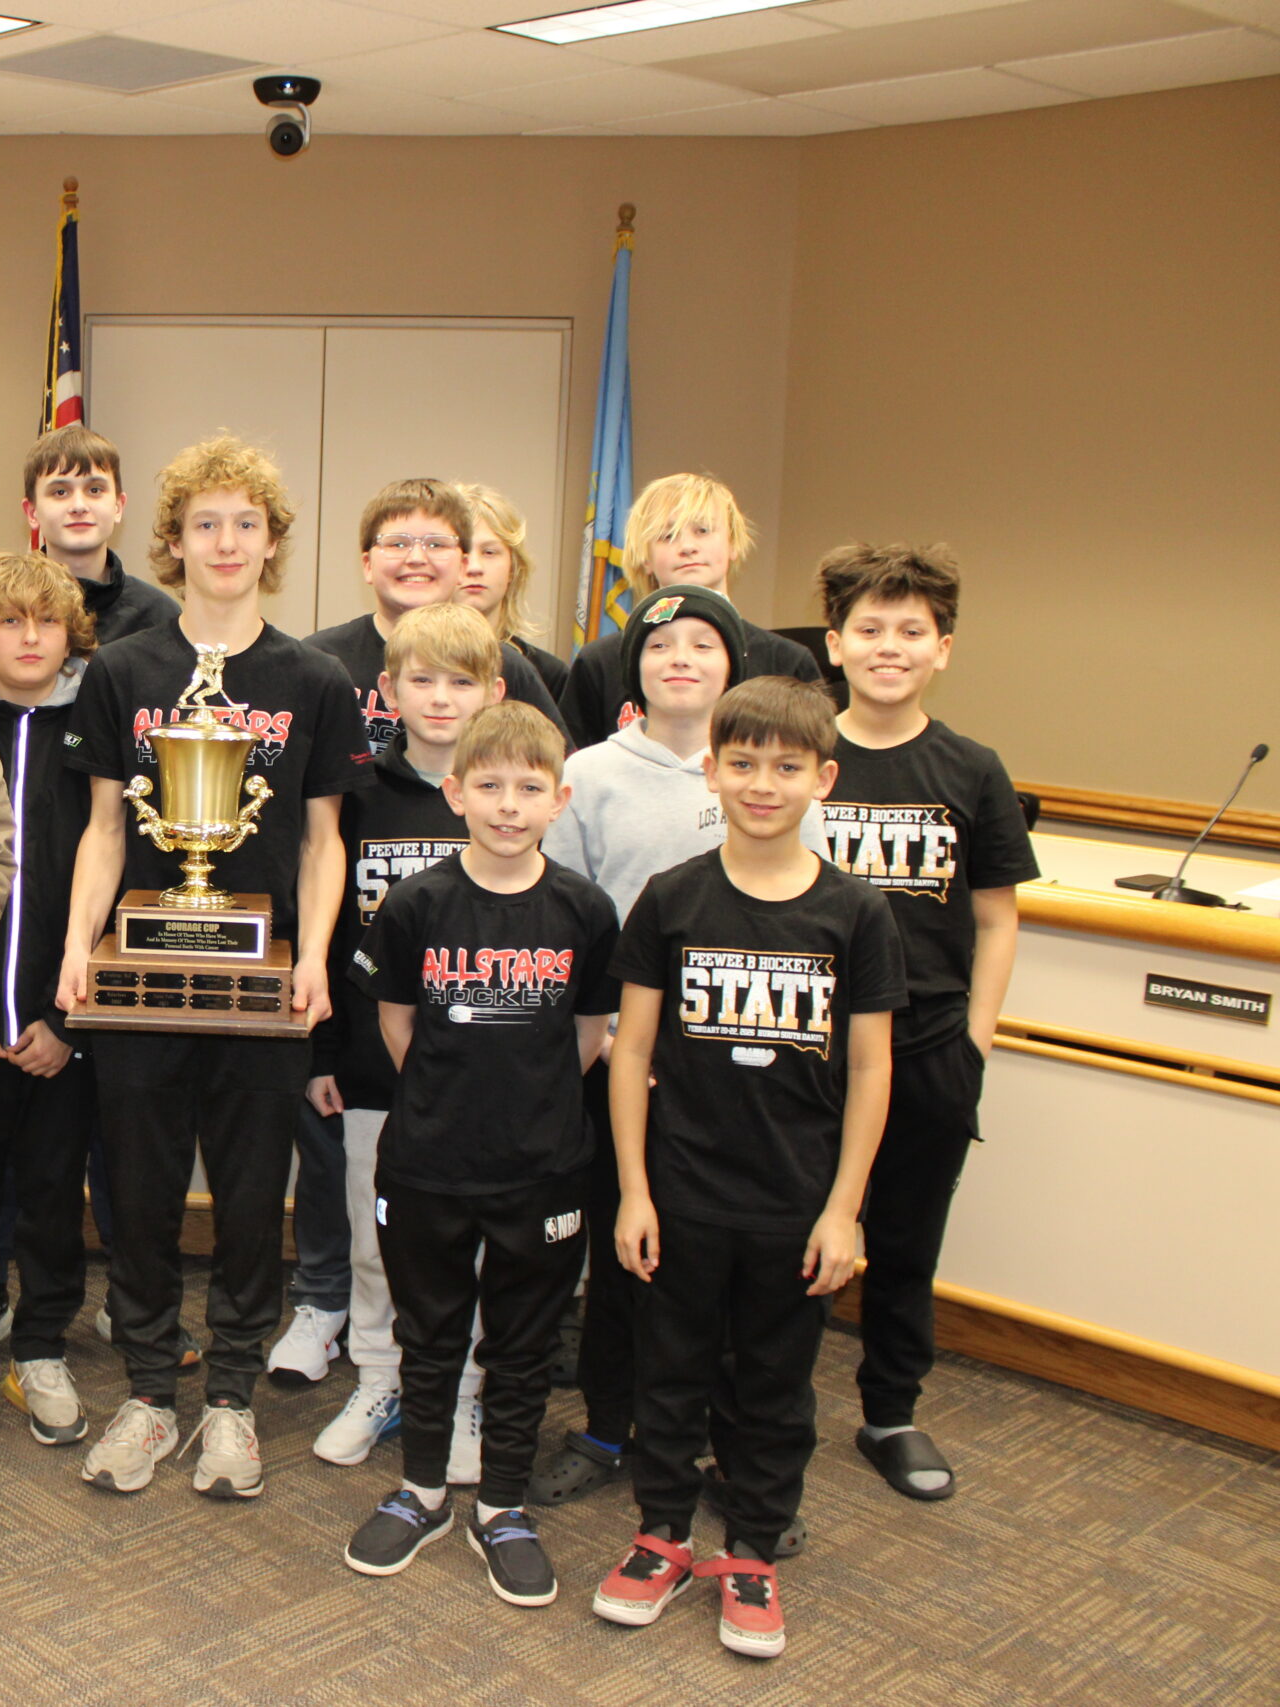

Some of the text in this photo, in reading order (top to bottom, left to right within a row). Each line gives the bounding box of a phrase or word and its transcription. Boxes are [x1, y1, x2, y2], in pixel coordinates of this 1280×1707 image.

[133, 707, 293, 750] ALARS
[698, 806, 718, 830] LOS
[822, 805, 923, 823] WEE B HOCKEY
[368, 842, 467, 857] PEEWEE B HOC
[824, 820, 957, 879] TATE
[165, 921, 220, 933] COURAGE CUP
[421, 947, 574, 992] ALLSTARS
[689, 951, 811, 973] PEEWEE B HOCKEY
[426, 986, 566, 1007] HOCKEY
[679, 966, 837, 1033] STATE
[1149, 983, 1265, 1013] BRYAN SMITH
